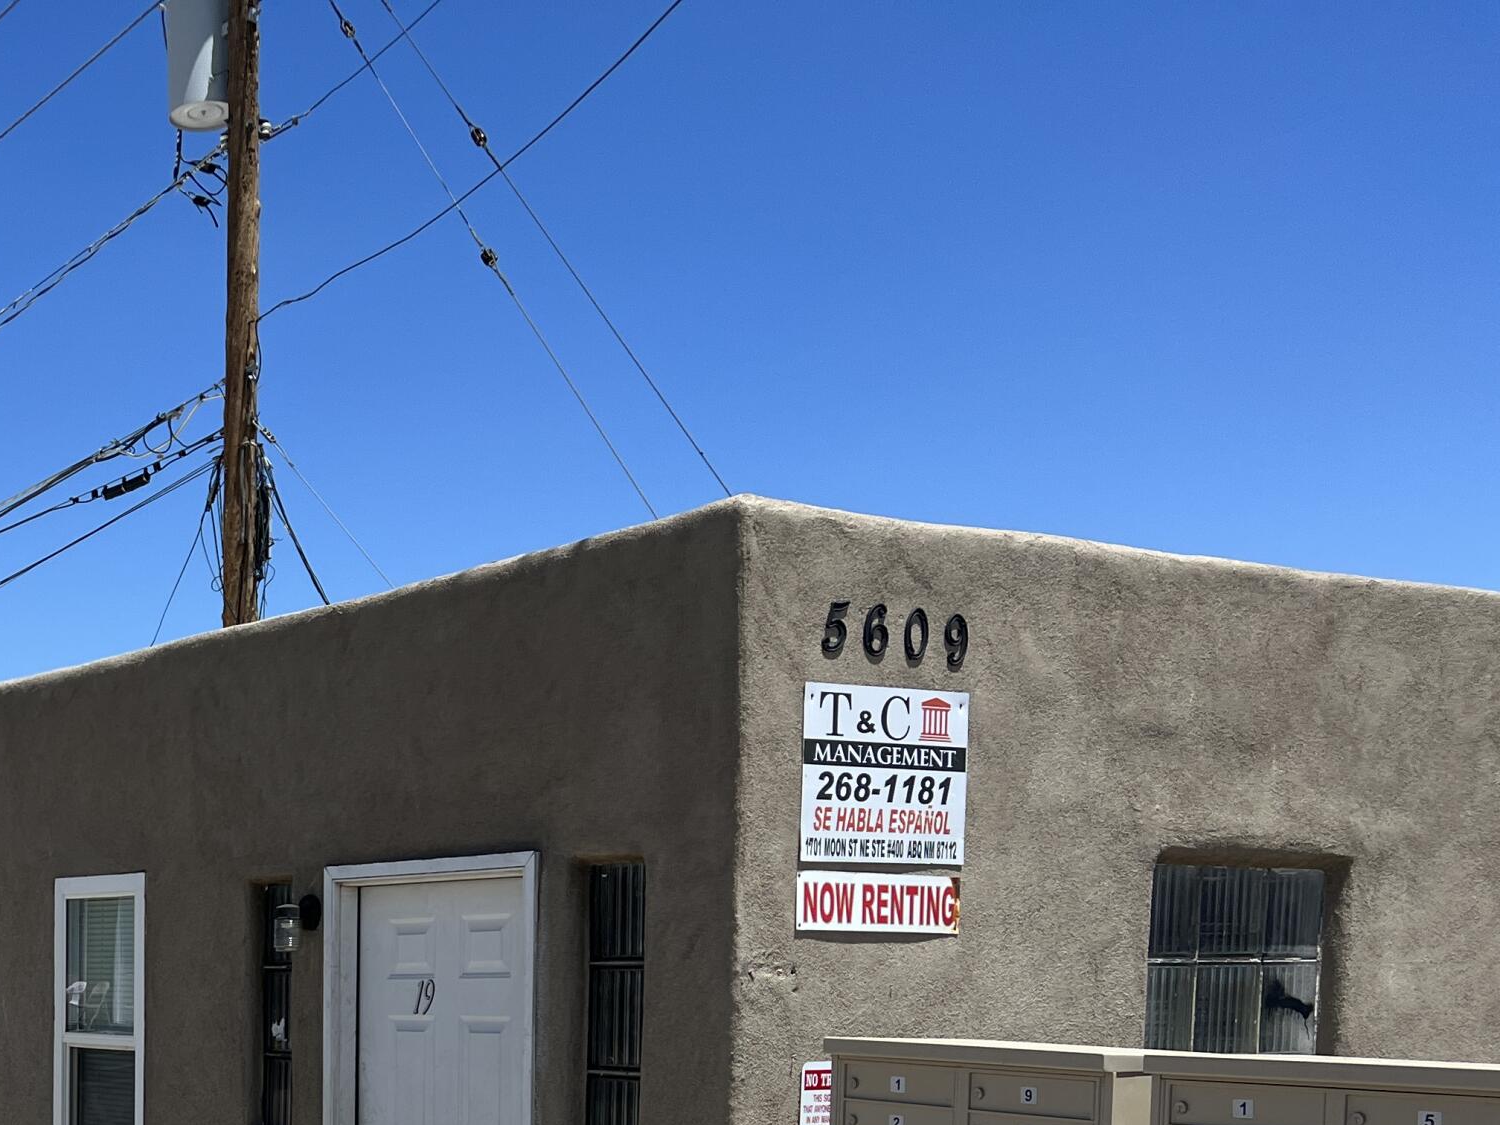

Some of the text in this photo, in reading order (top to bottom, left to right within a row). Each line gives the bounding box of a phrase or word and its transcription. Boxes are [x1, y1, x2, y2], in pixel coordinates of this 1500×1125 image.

[821, 601, 968, 665] 5609
[813, 743, 957, 769] MANAGEMENT
[816, 771, 952, 806] 268-1181
[813, 804, 951, 836] SE HABLA ESPAÑOL
[805, 837, 822, 856] 1701
[824, 837, 847, 857] MOON
[848, 838, 858, 857] ST
[860, 839, 870, 858] NE
[871, 839, 886, 858] STE
[907, 840, 923, 859] ABQ
[924, 841, 935, 859] NM
[936, 841, 957, 860] 87112
[803, 881, 956, 927] NOW RENTING
[413, 979, 436, 1015] 19
[805, 1073, 819, 1087] NO
[895, 1079, 901, 1091] 1
[1024, 1089, 1033, 1102] 9
[1239, 1101, 1247, 1116] 1
